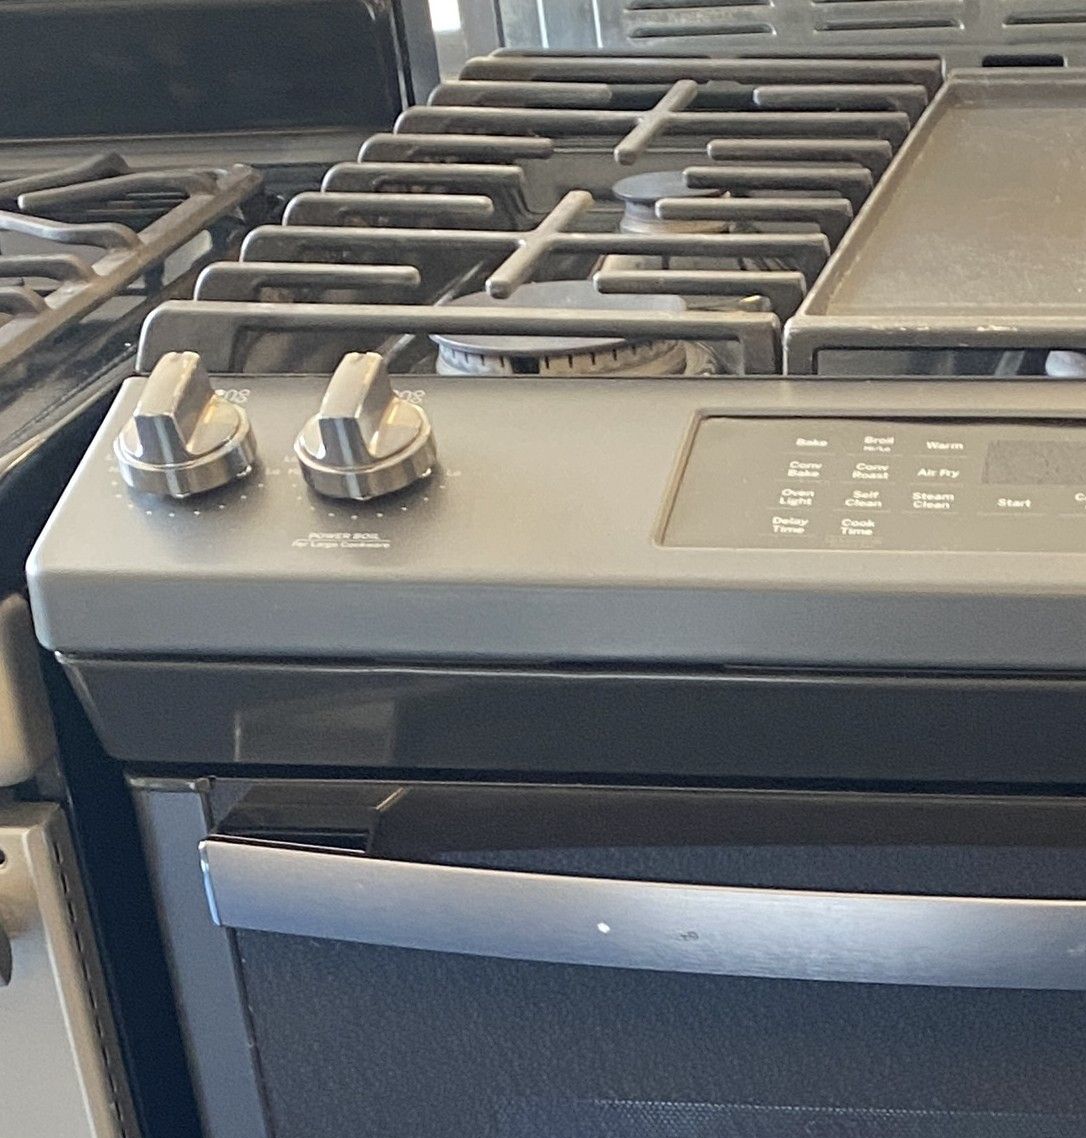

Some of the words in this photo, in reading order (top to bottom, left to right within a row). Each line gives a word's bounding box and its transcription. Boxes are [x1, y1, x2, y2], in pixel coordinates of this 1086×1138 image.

[796, 438, 828, 447] Bake
[864, 436, 895, 445] Broil
[926, 441, 964, 450] Warm
[789, 461, 822, 469] Conv
[855, 463, 890, 471] Conv
[788, 469, 820, 477] Bake
[852, 471, 889, 480] Roast
[917, 468, 937, 477] Air
[939, 469, 960, 479] Fry
[781, 488, 815, 497] Oven
[852, 490, 880, 499] Self
[912, 492, 955, 501] Steam
[779, 496, 812, 506] Light
[845, 499, 882, 508] Clean
[913, 500, 951, 509] Clean
[998, 498, 1031, 508] Start
[772, 516, 809, 527] Delay
[841, 518, 875, 528] Cook
[772, 525, 805, 534] Time
[840, 527, 873, 535] Time
[309, 532, 351, 540] POWER
[353, 532, 379, 540] BOIL
